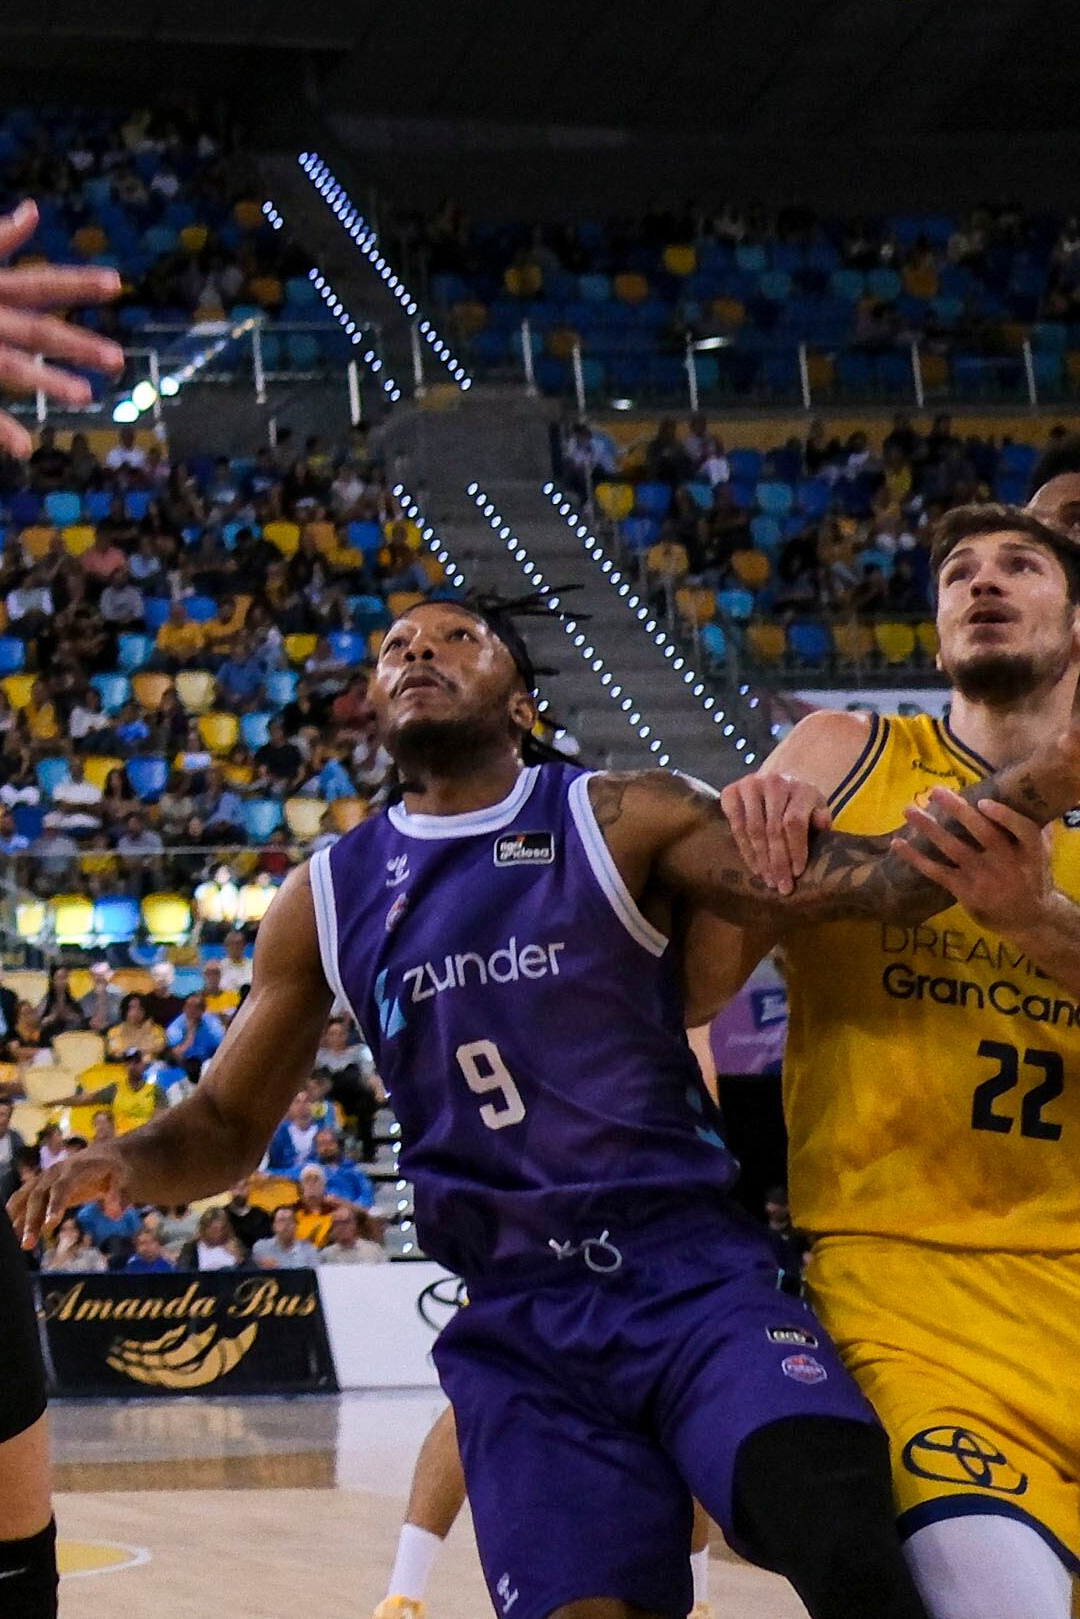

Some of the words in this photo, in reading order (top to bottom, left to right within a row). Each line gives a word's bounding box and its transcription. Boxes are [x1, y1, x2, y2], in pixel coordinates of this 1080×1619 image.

[403, 936, 565, 1003] zunder
[883, 962, 1080, 1030] GranCan
[455, 1039, 526, 1130] 9
[971, 1039, 1064, 1142] 22
[39, 1281, 218, 1322] Amanda
[228, 1278, 318, 1318] Bus
